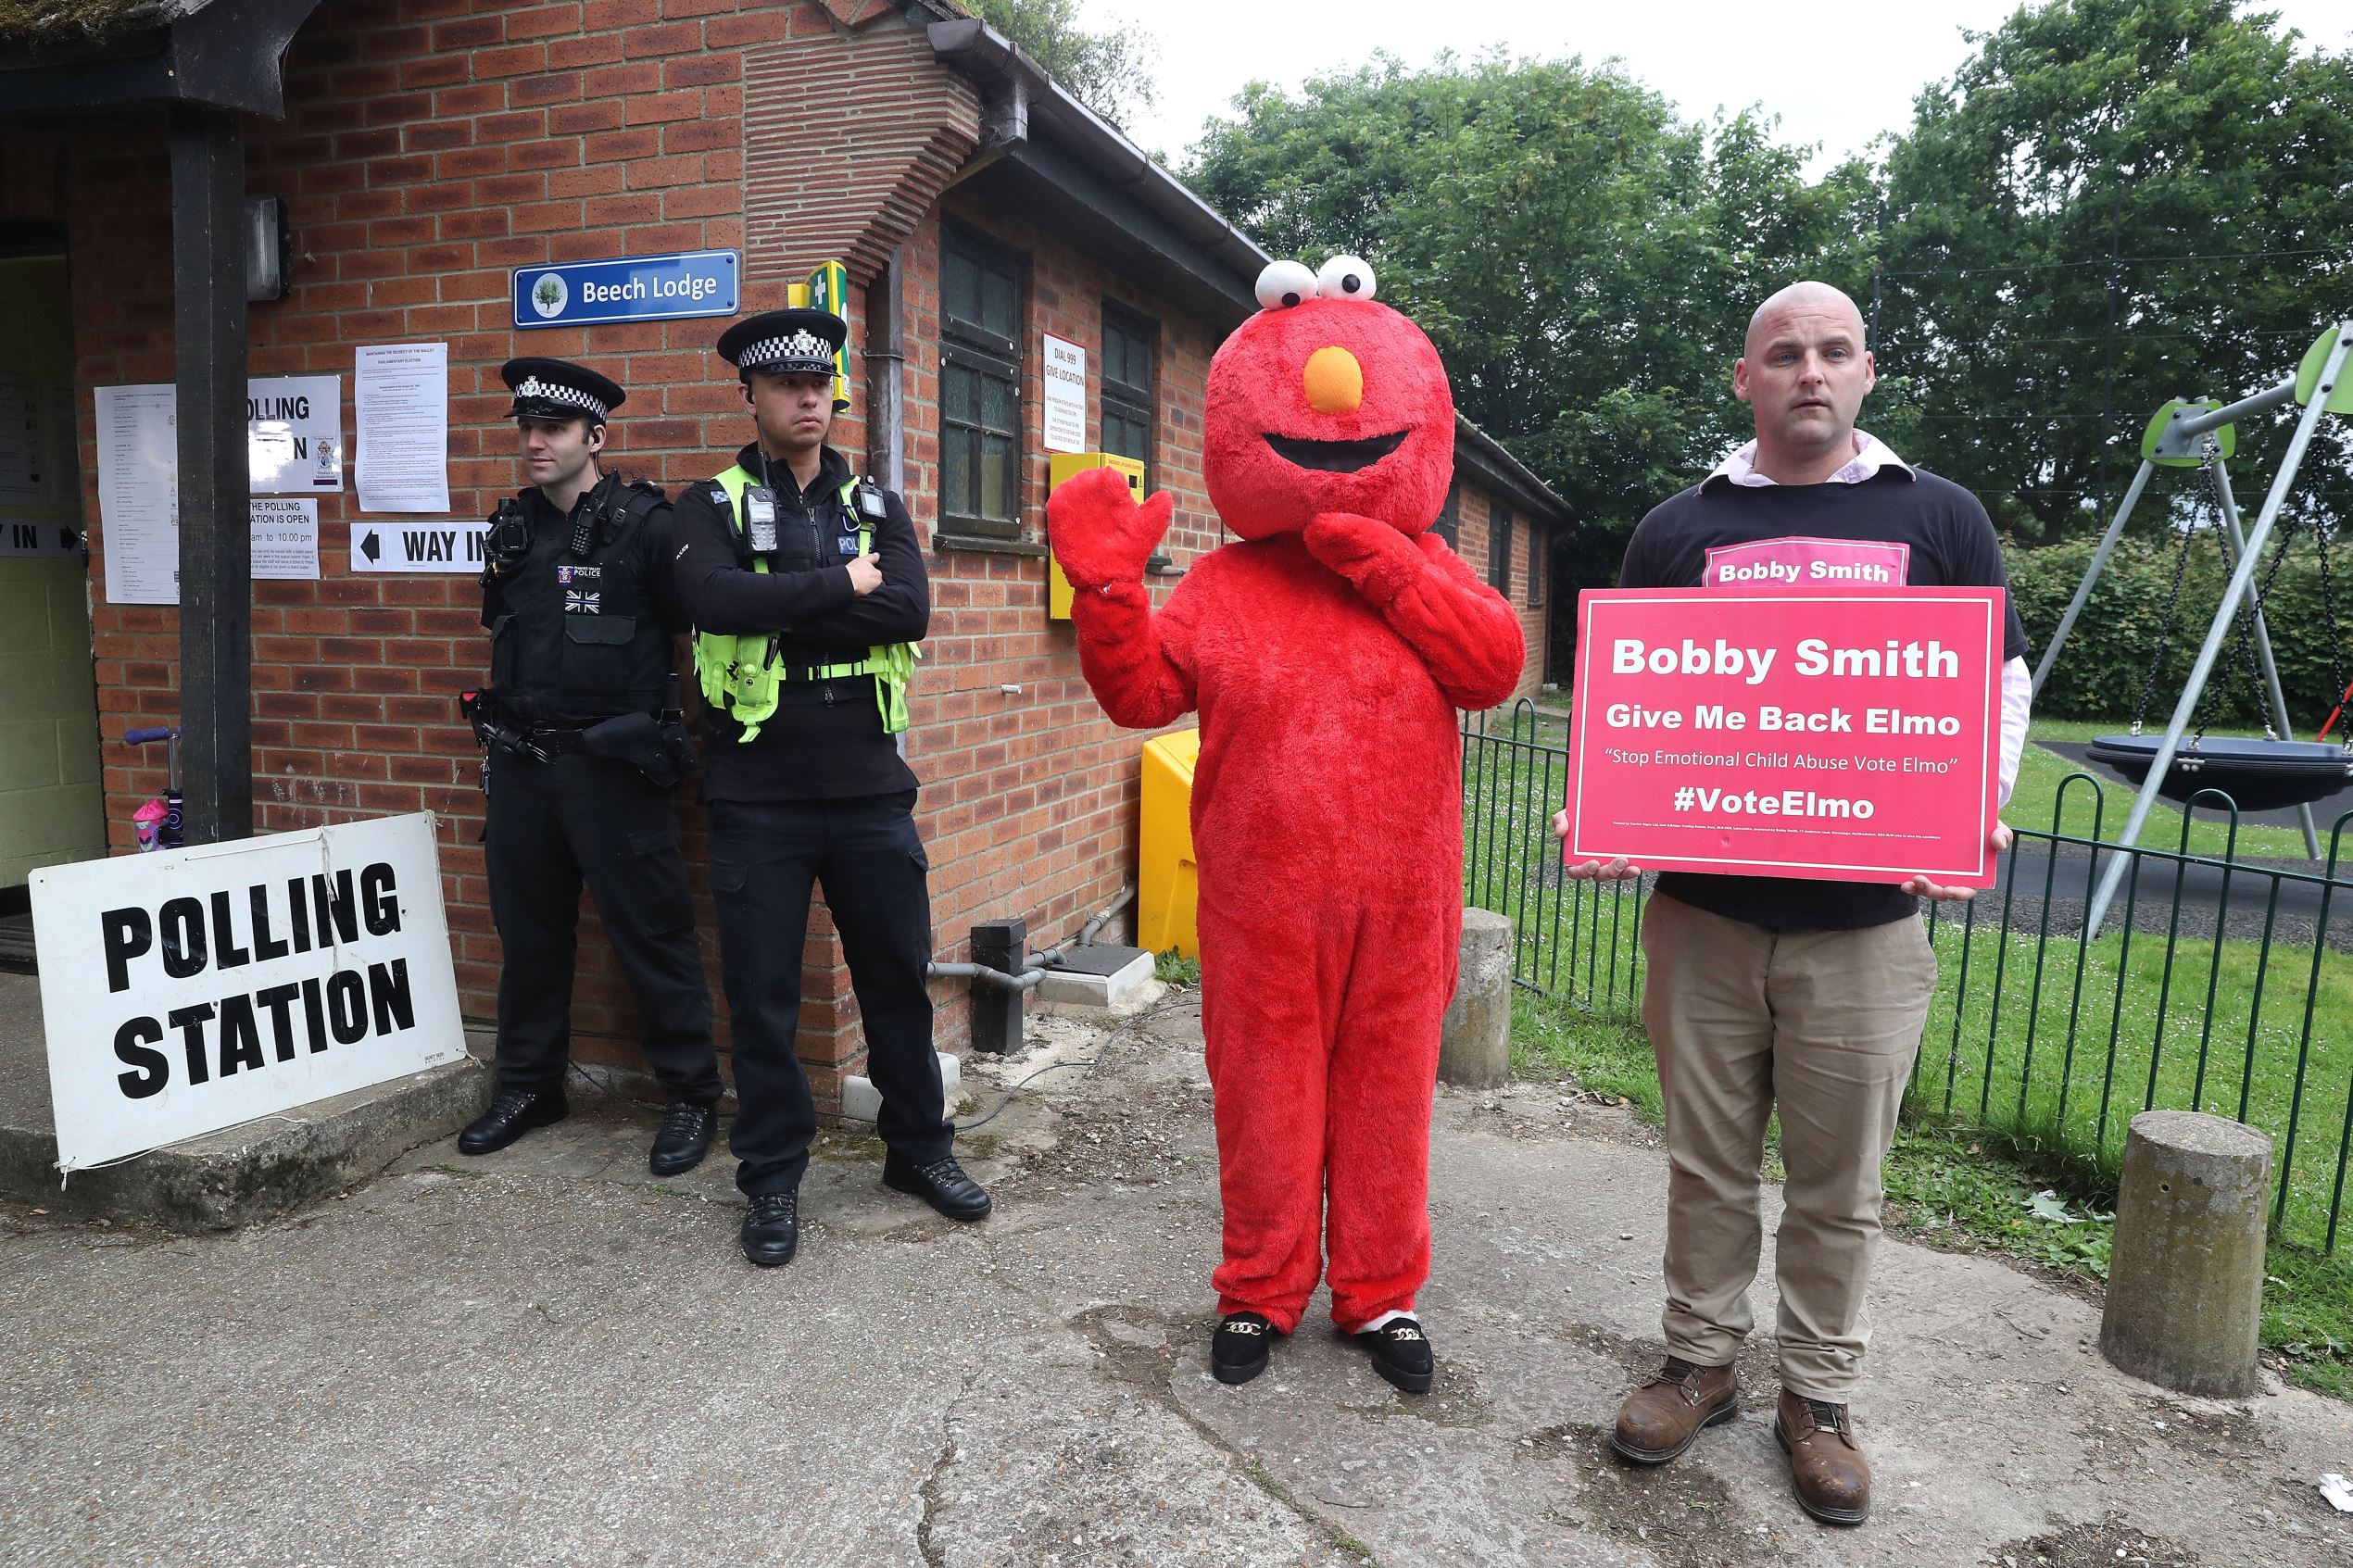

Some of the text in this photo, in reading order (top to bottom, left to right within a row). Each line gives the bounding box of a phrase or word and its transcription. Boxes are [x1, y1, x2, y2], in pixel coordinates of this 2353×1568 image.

[583, 272, 717, 303] Beech Lodge
[1054, 347, 1076, 365] DIAL 999
[1046, 365, 1084, 387] GIVE LOCATION
[250, 502, 300, 511] HE POLLING
[276, 515, 283, 524] IS
[287, 515, 309, 524] OPEN
[13, 524, 38, 548] IN
[300, 534, 311, 543] pm
[402, 531, 457, 561] WAY
[1718, 559, 1890, 583] Bobby Smith
[1612, 638, 1959, 685] Bobby Smith
[1605, 703, 1961, 736] Give Me Back Elmo
[1604, 748, 1958, 774] “Stop Emotional Child Abuse Vote Elmo”
[1673, 786, 1874, 820] #VoteElmo
[101, 862, 402, 993] POLLING
[113, 958, 416, 1099] STATION
